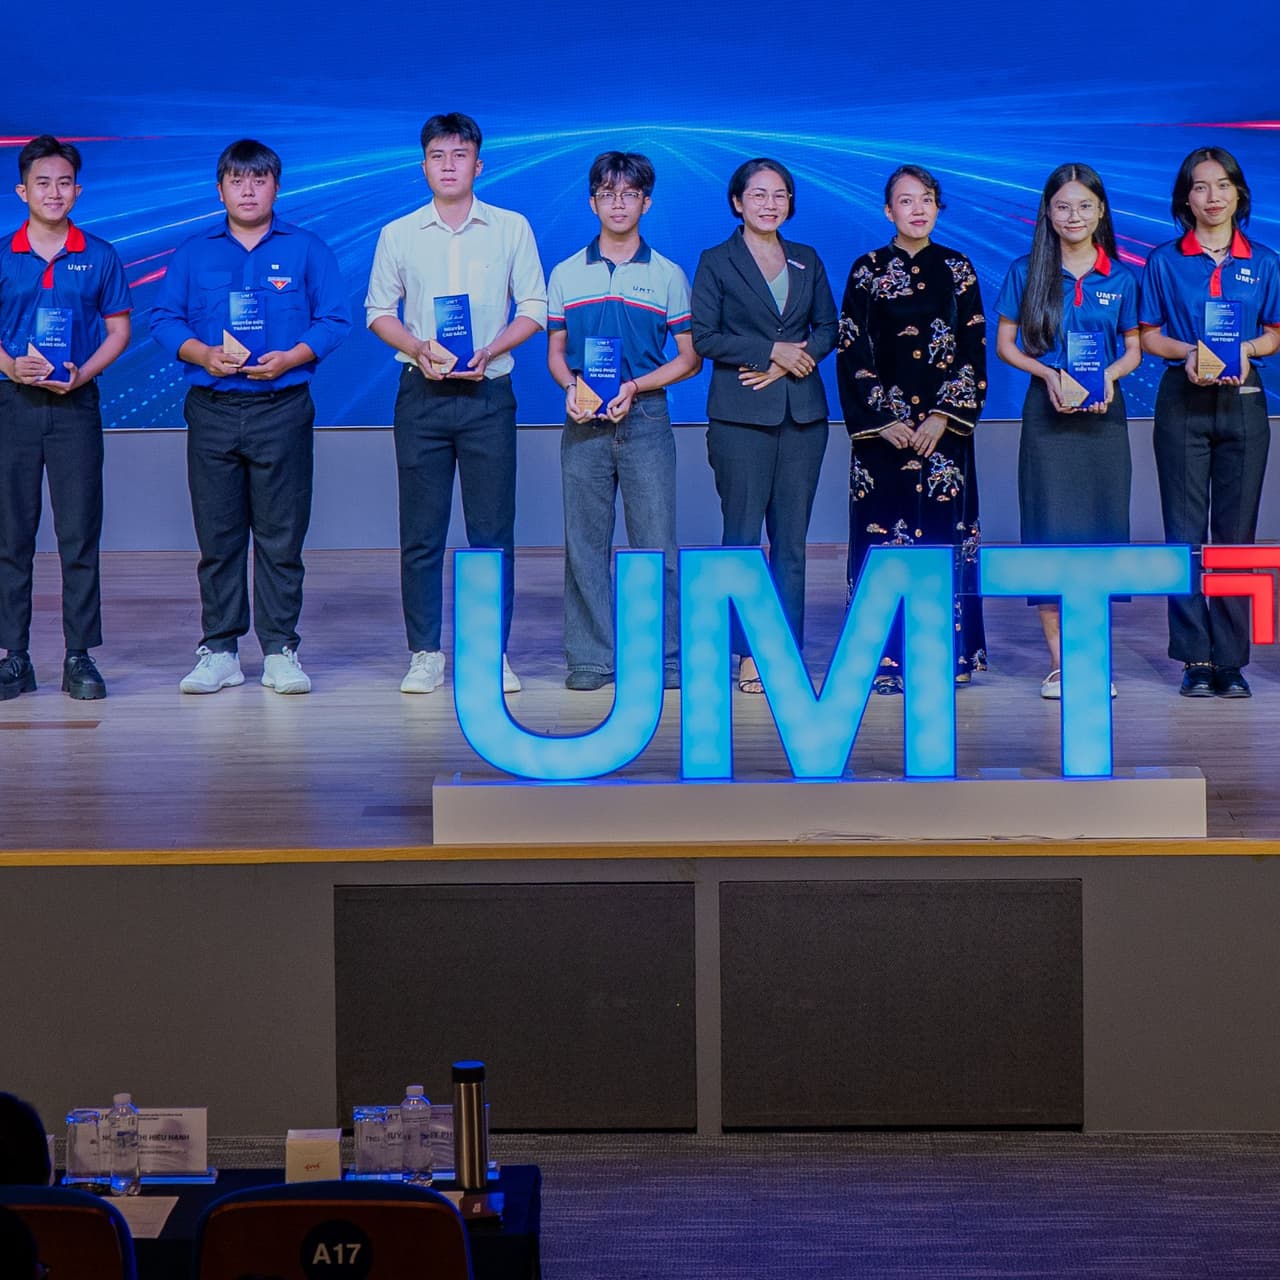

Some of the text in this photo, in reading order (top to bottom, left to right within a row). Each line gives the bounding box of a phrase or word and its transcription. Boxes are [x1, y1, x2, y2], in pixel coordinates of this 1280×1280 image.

[67, 263, 88, 271] UMT
[1235, 273, 1255, 284] UMT
[1096, 291, 1117, 300] UMT
[451, 543, 1192, 781] UMT
[312, 1242, 362, 1265] A17
